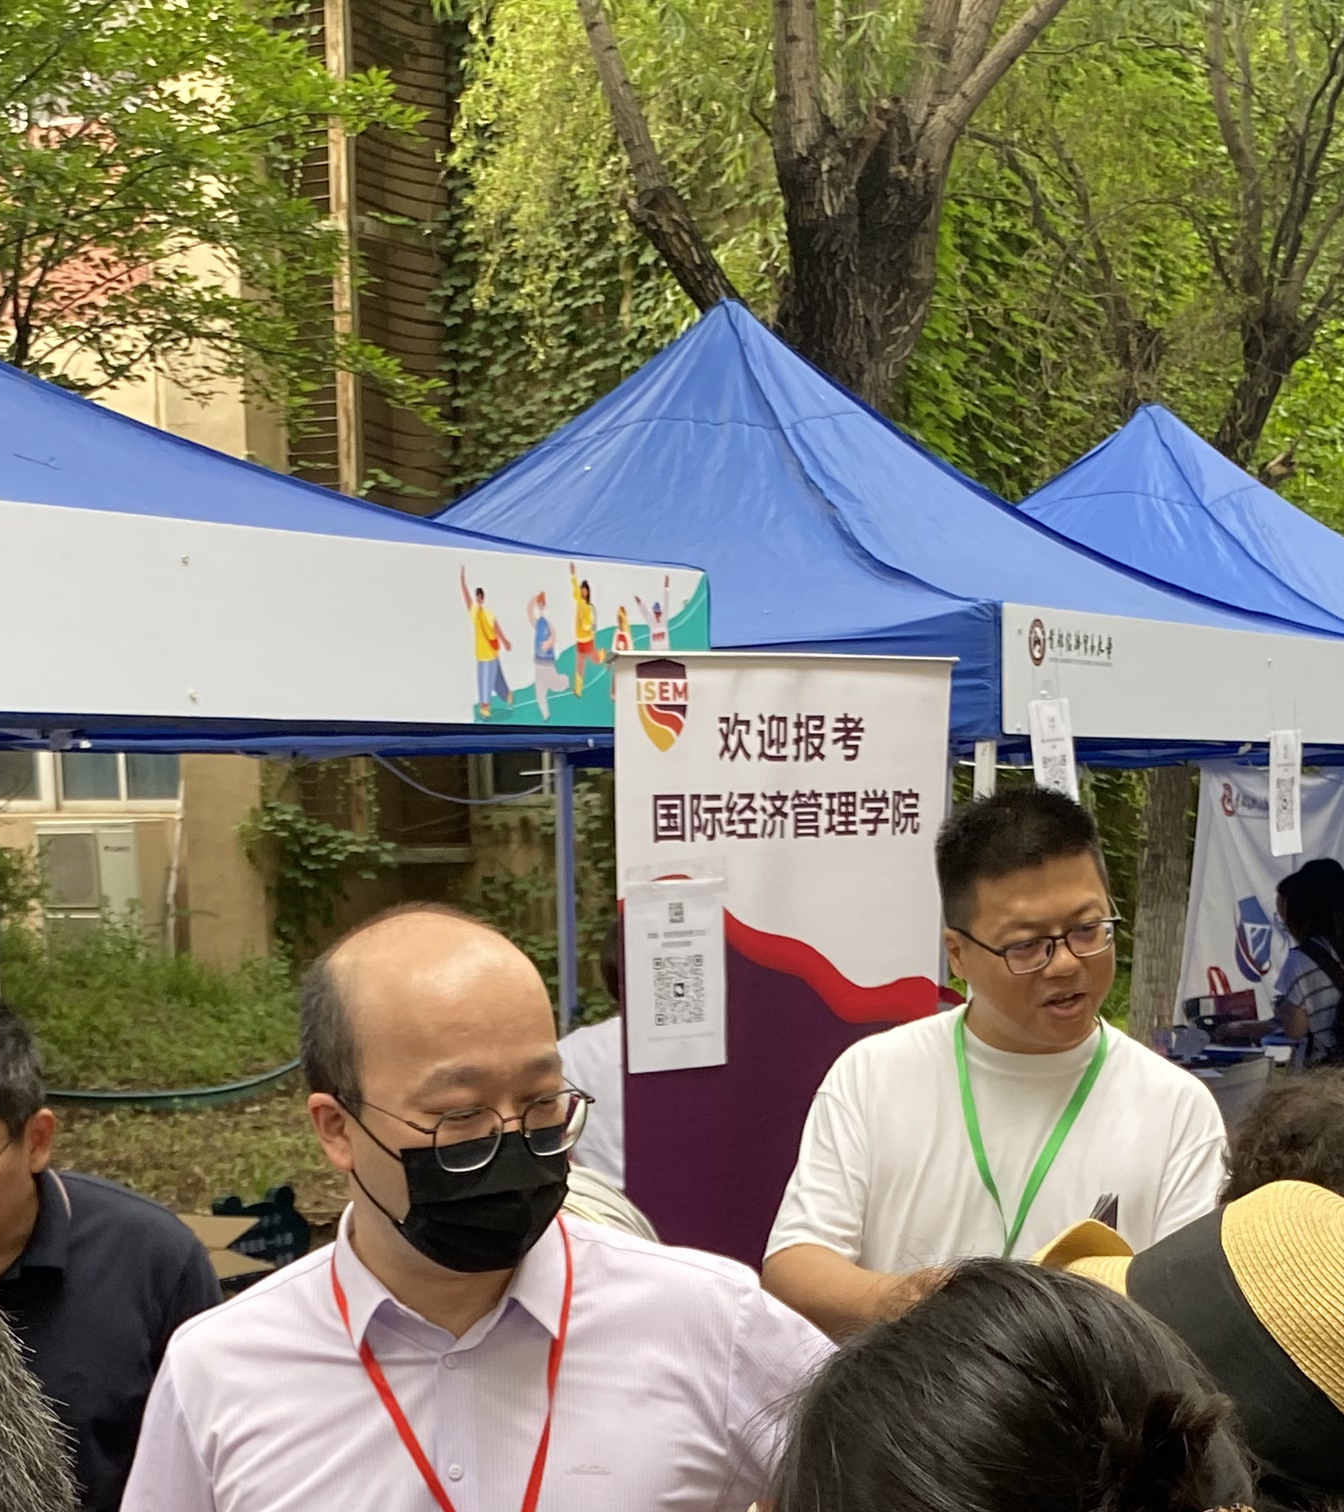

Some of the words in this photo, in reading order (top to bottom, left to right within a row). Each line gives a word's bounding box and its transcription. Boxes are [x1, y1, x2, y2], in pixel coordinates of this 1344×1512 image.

[636, 680, 689, 701] ISEM
[718, 713, 865, 763] 欢迎报考
[652, 788, 920, 843] 国际经济管理学院
